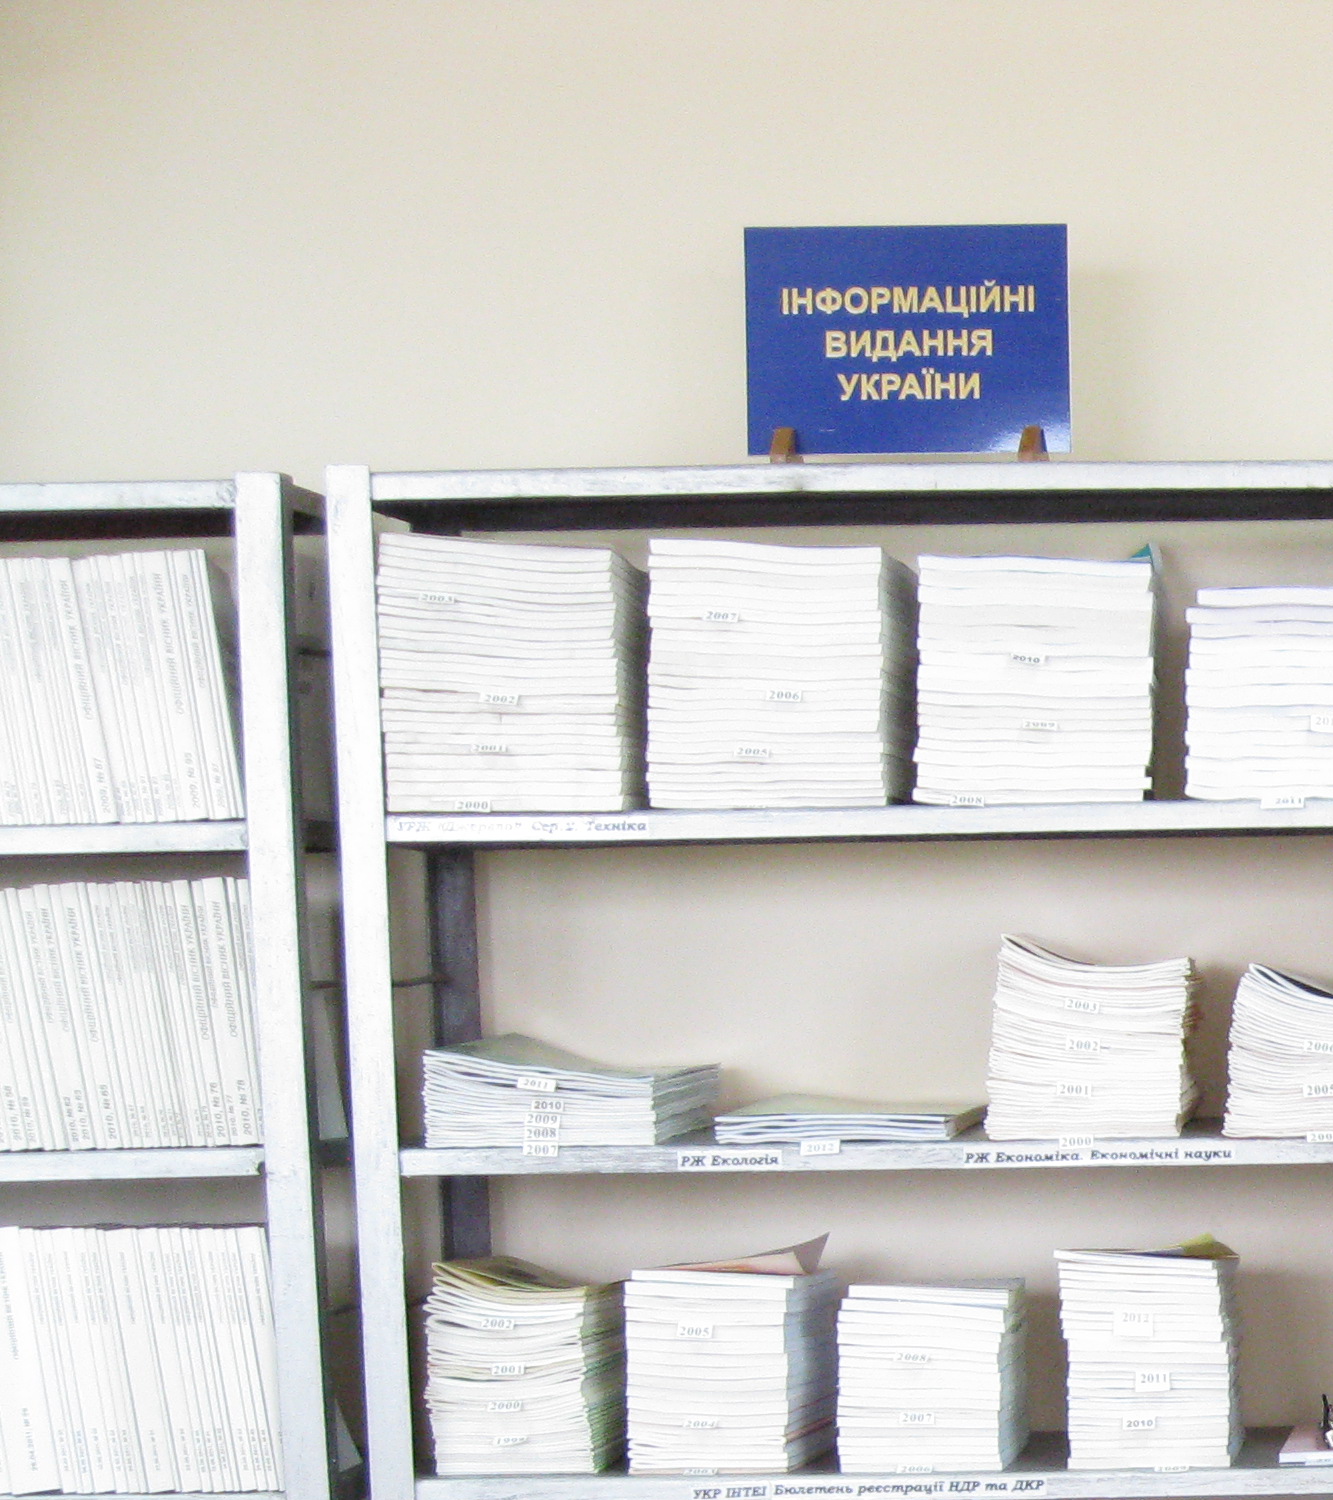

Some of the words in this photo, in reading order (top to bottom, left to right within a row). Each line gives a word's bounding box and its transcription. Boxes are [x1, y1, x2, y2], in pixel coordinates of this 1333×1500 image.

[781, 280, 1035, 317] ІНФОРМАЦІЙНІ
[826, 329, 992, 362] ВИДАННЯ
[837, 368, 981, 400] УКРАЇНИ
[706, 611, 737, 621] 2007
[769, 690, 800, 701] 2006
[457, 800, 489, 810] 2000
[951, 795, 983, 805] 2008
[587, 821, 647, 832] Техніка
[1067, 1000, 1098, 1012] 2003
[1069, 1040, 1099, 1051] 2002
[1060, 1084, 1090, 1096] 2001
[534, 1101, 562, 1111] 2010
[526, 1114, 558, 1125] 2009
[526, 1128, 557, 1139] 2008
[1061, 1136, 1092, 1147] 2000
[526, 1145, 557, 1155] 2007
[807, 1142, 835, 1153] 2012
[680, 1153, 707, 1168] РЖ
[711, 1152, 779, 1167] Екологія
[965, 1151, 992, 1164] РЖ
[1090, 1147, 1179, 1161] Економічні
[1183, 1149, 1233, 1163] науки
[482, 1319, 512, 1329] 2002
[680, 1327, 710, 1336] 2005
[493, 1365, 523, 1374] 2001
[1140, 1373, 1167, 1384] 2011
[489, 1401, 520, 1410] 2000
[903, 1413, 932, 1422] 2007
[1126, 1419, 1153, 1428] 2010
[692, 1488, 721, 1500] УКР
[725, 1486, 767, 1499] ІНТЕІ
[773, 1484, 853, 1497] Бюлетень
[857, 1481, 943, 1497] реєстрації
[948, 1480, 982, 1494] НДР
[986, 1482, 1008, 1491] та
[1011, 1479, 1045, 1493] ДКР
